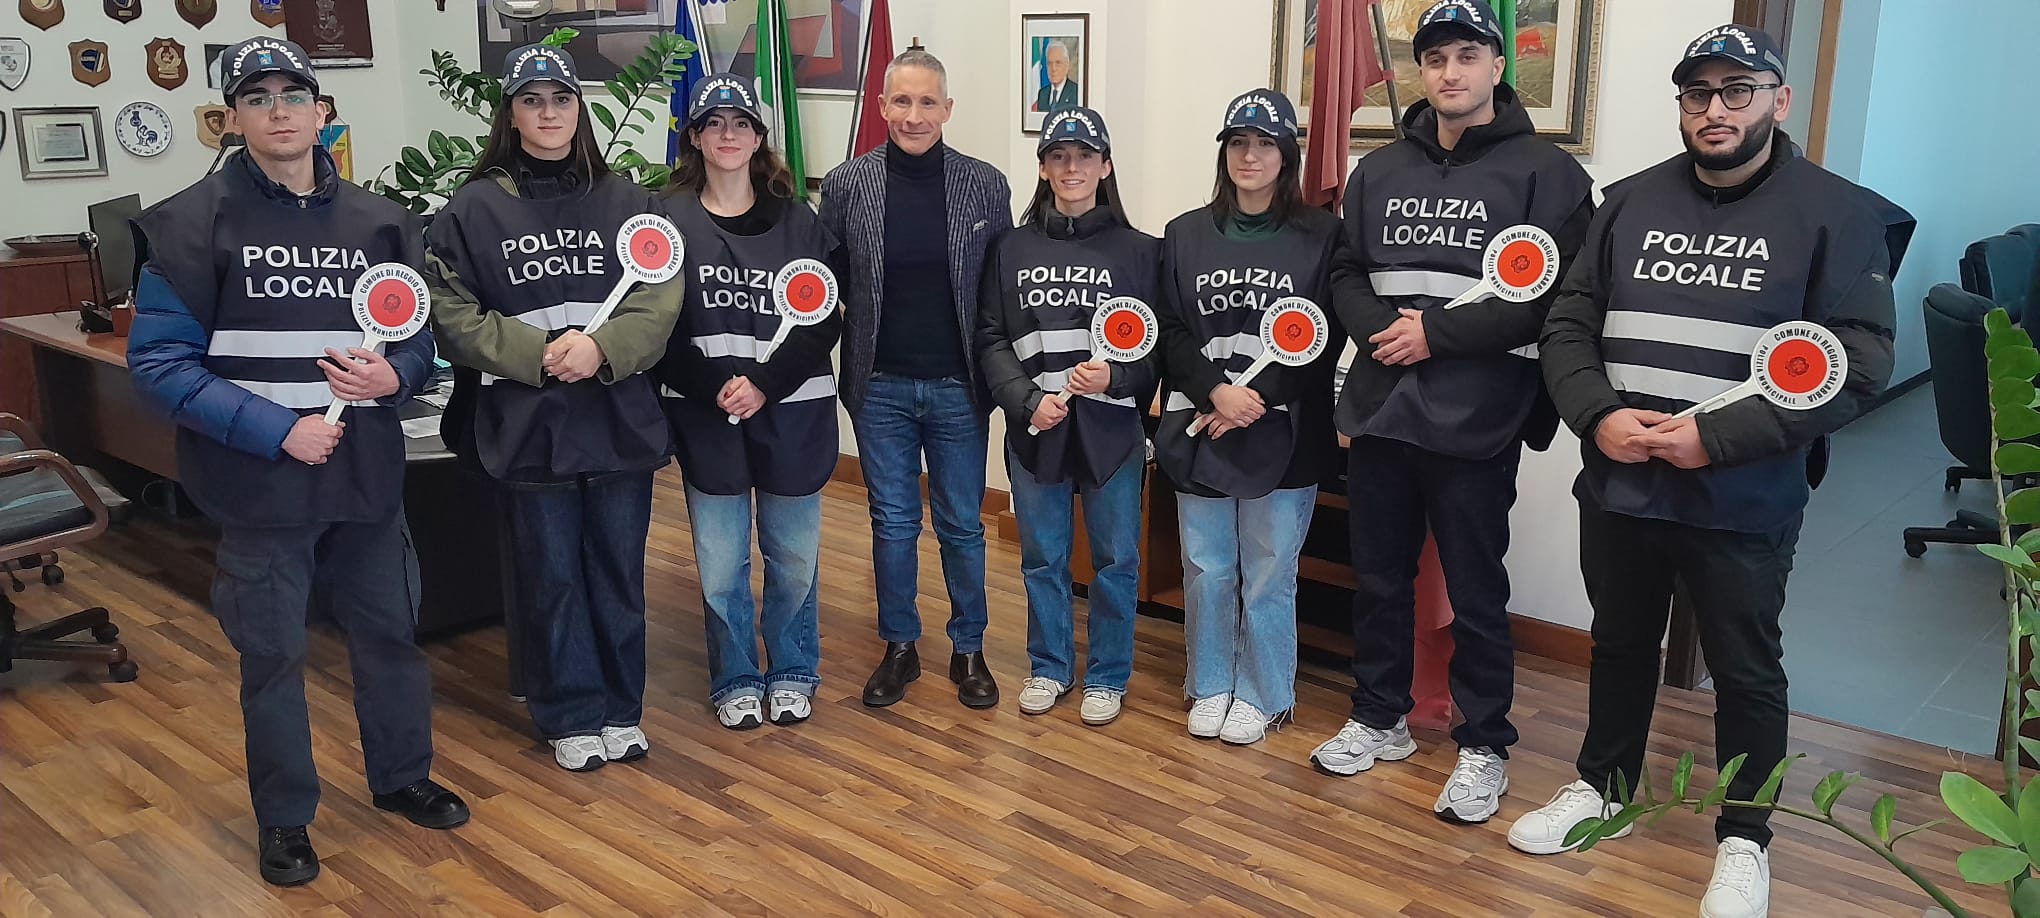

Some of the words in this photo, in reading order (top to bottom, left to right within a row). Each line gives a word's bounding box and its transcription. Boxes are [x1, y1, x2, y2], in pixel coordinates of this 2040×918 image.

[1423, 0, 1450, 25] OLIZIA
[1721, 26, 1757, 55] LOCALE
[233, 41, 261, 76] POLIZIA
[263, 39, 303, 69] LOCALE
[512, 48, 538, 78] POLIZIA
[540, 47, 571, 77] LOCALE
[698, 78, 724, 106] POLIZIA
[726, 78, 753, 107] LOCALE
[1226, 95, 1252, 125] POLIZIA
[1253, 95, 1279, 123] LOCALE
[1044, 110, 1069, 140] POLIZIA
[1070, 110, 1098, 137] LOCALE
[648, 218, 655, 226] DI
[1385, 197, 1488, 222] POLIZIA
[501, 228, 604, 259] POLIZIA
[1382, 224, 1485, 250] LOCALE
[1501, 231, 1530, 244] COMUNE
[1531, 233, 1540, 242] DI
[1642, 230, 1770, 261] POLIZIA
[242, 245, 370, 270] POLIZIA
[507, 254, 604, 286] LOCALE
[245, 275, 357, 299] LOCAL
[360, 270, 385, 294] COMUNE
[385, 268, 394, 277] DI
[395, 269, 419, 288] REGGIO
[699, 265, 774, 290] POLIZI
[1017, 266, 1113, 288] POLIZIA
[1196, 267, 1294, 293] POLIZIA
[1633, 258, 1766, 291] LOCALE
[1197, 290, 1282, 316] LOCAL
[1774, 328, 1811, 341] COMUNE
[1811, 332, 1822, 342] DI
[1755, 345, 1769, 373] POLIZIA
[1820, 339, 1839, 368] REGGIO
[1758, 375, 1797, 405] MUNICIPALE
[1808, 370, 1839, 402] CALABRIA
